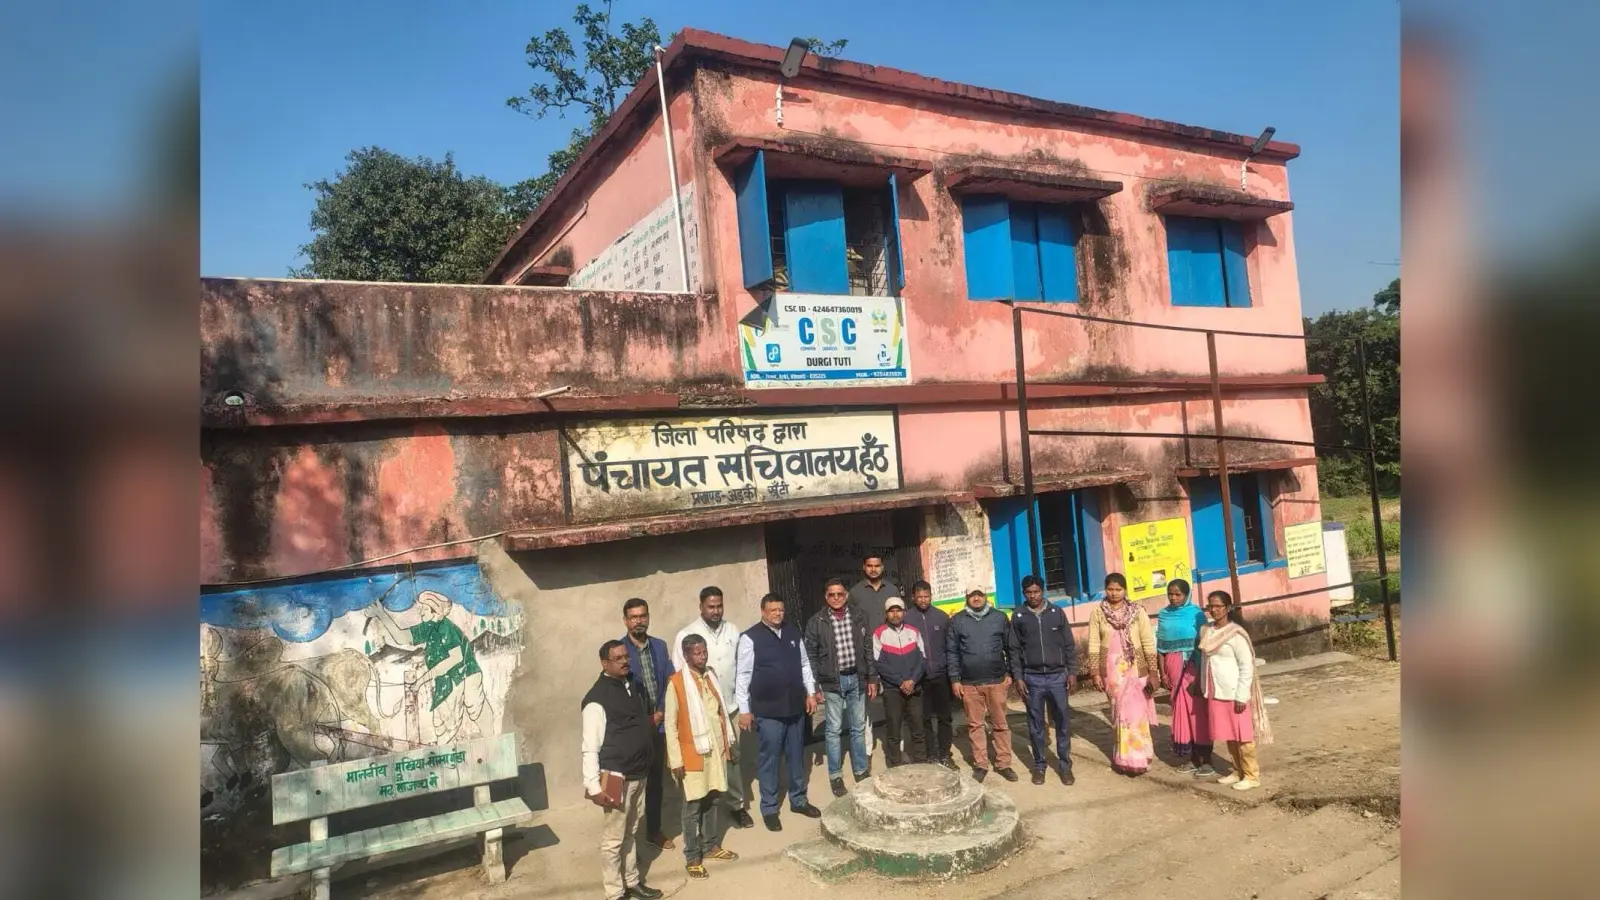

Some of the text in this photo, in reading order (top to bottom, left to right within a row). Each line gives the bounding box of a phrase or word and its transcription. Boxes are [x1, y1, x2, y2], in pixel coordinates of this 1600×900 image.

[784, 305, 798, 313] CSC
[798, 305, 807, 313] ID
[806, 357, 852, 366] DURGI TUTI
[652, 421, 698, 447] जिला
[773, 422, 808, 444] द्वारा
[577, 450, 709, 494] पंचायत
